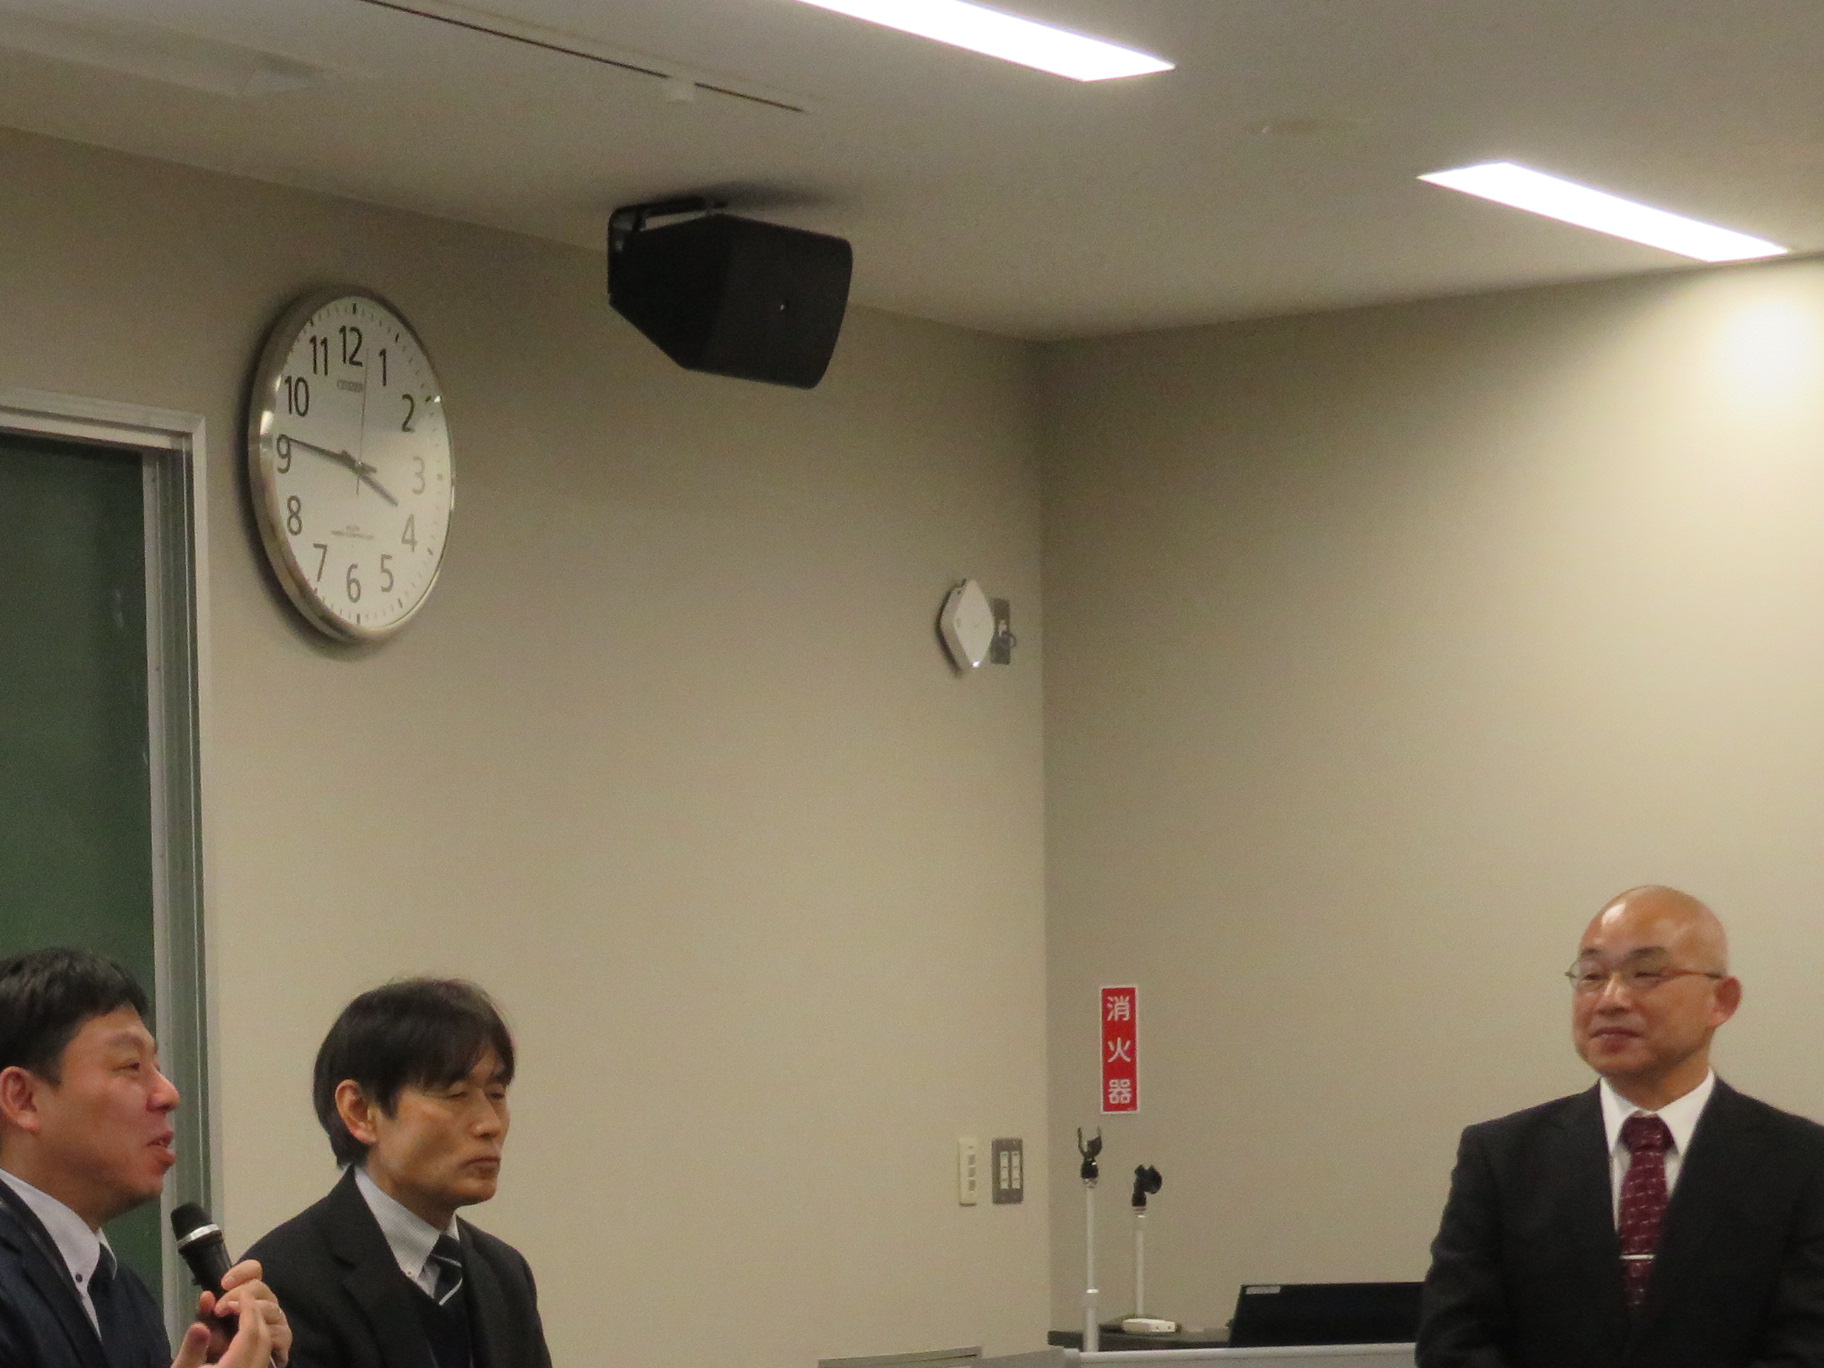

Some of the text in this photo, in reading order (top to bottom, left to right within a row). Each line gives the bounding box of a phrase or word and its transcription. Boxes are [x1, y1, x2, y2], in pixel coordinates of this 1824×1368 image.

[309, 335, 329, 376] 11
[339, 325, 363, 367] 12
[379, 349, 388, 387] 1
[285, 375, 311, 417] 10
[401, 394, 416, 432] 2
[277, 434, 292, 474] 9
[412, 456, 426, 495] 3
[286, 495, 303, 535] 8
[401, 514, 417, 552] 4
[313, 543, 328, 582] 7
[380, 554, 394, 593] 5
[346, 564, 362, 603] 6
[1107, 995, 1132, 1105] 消火器
